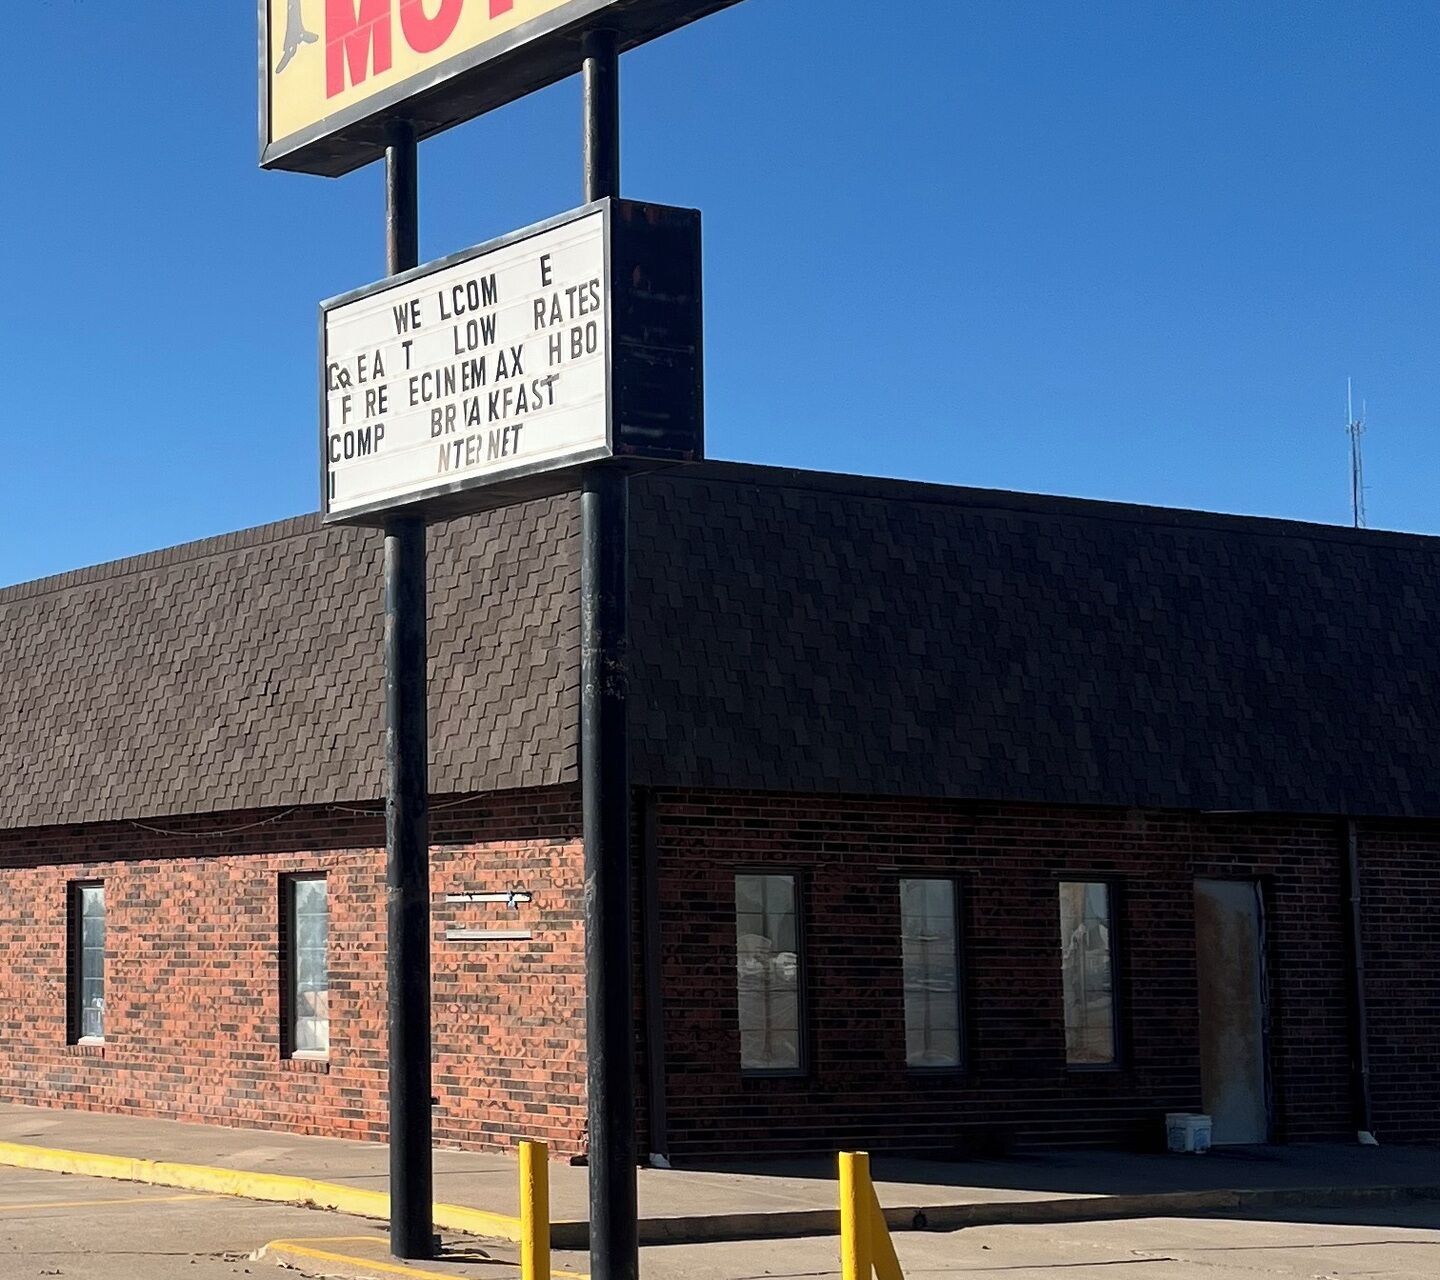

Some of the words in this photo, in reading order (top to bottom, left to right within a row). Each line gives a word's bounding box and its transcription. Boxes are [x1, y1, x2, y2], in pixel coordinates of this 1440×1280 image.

[454, 313, 496, 355] LOW
[533, 278, 600, 330] RATES
[329, 422, 385, 463] COMP
